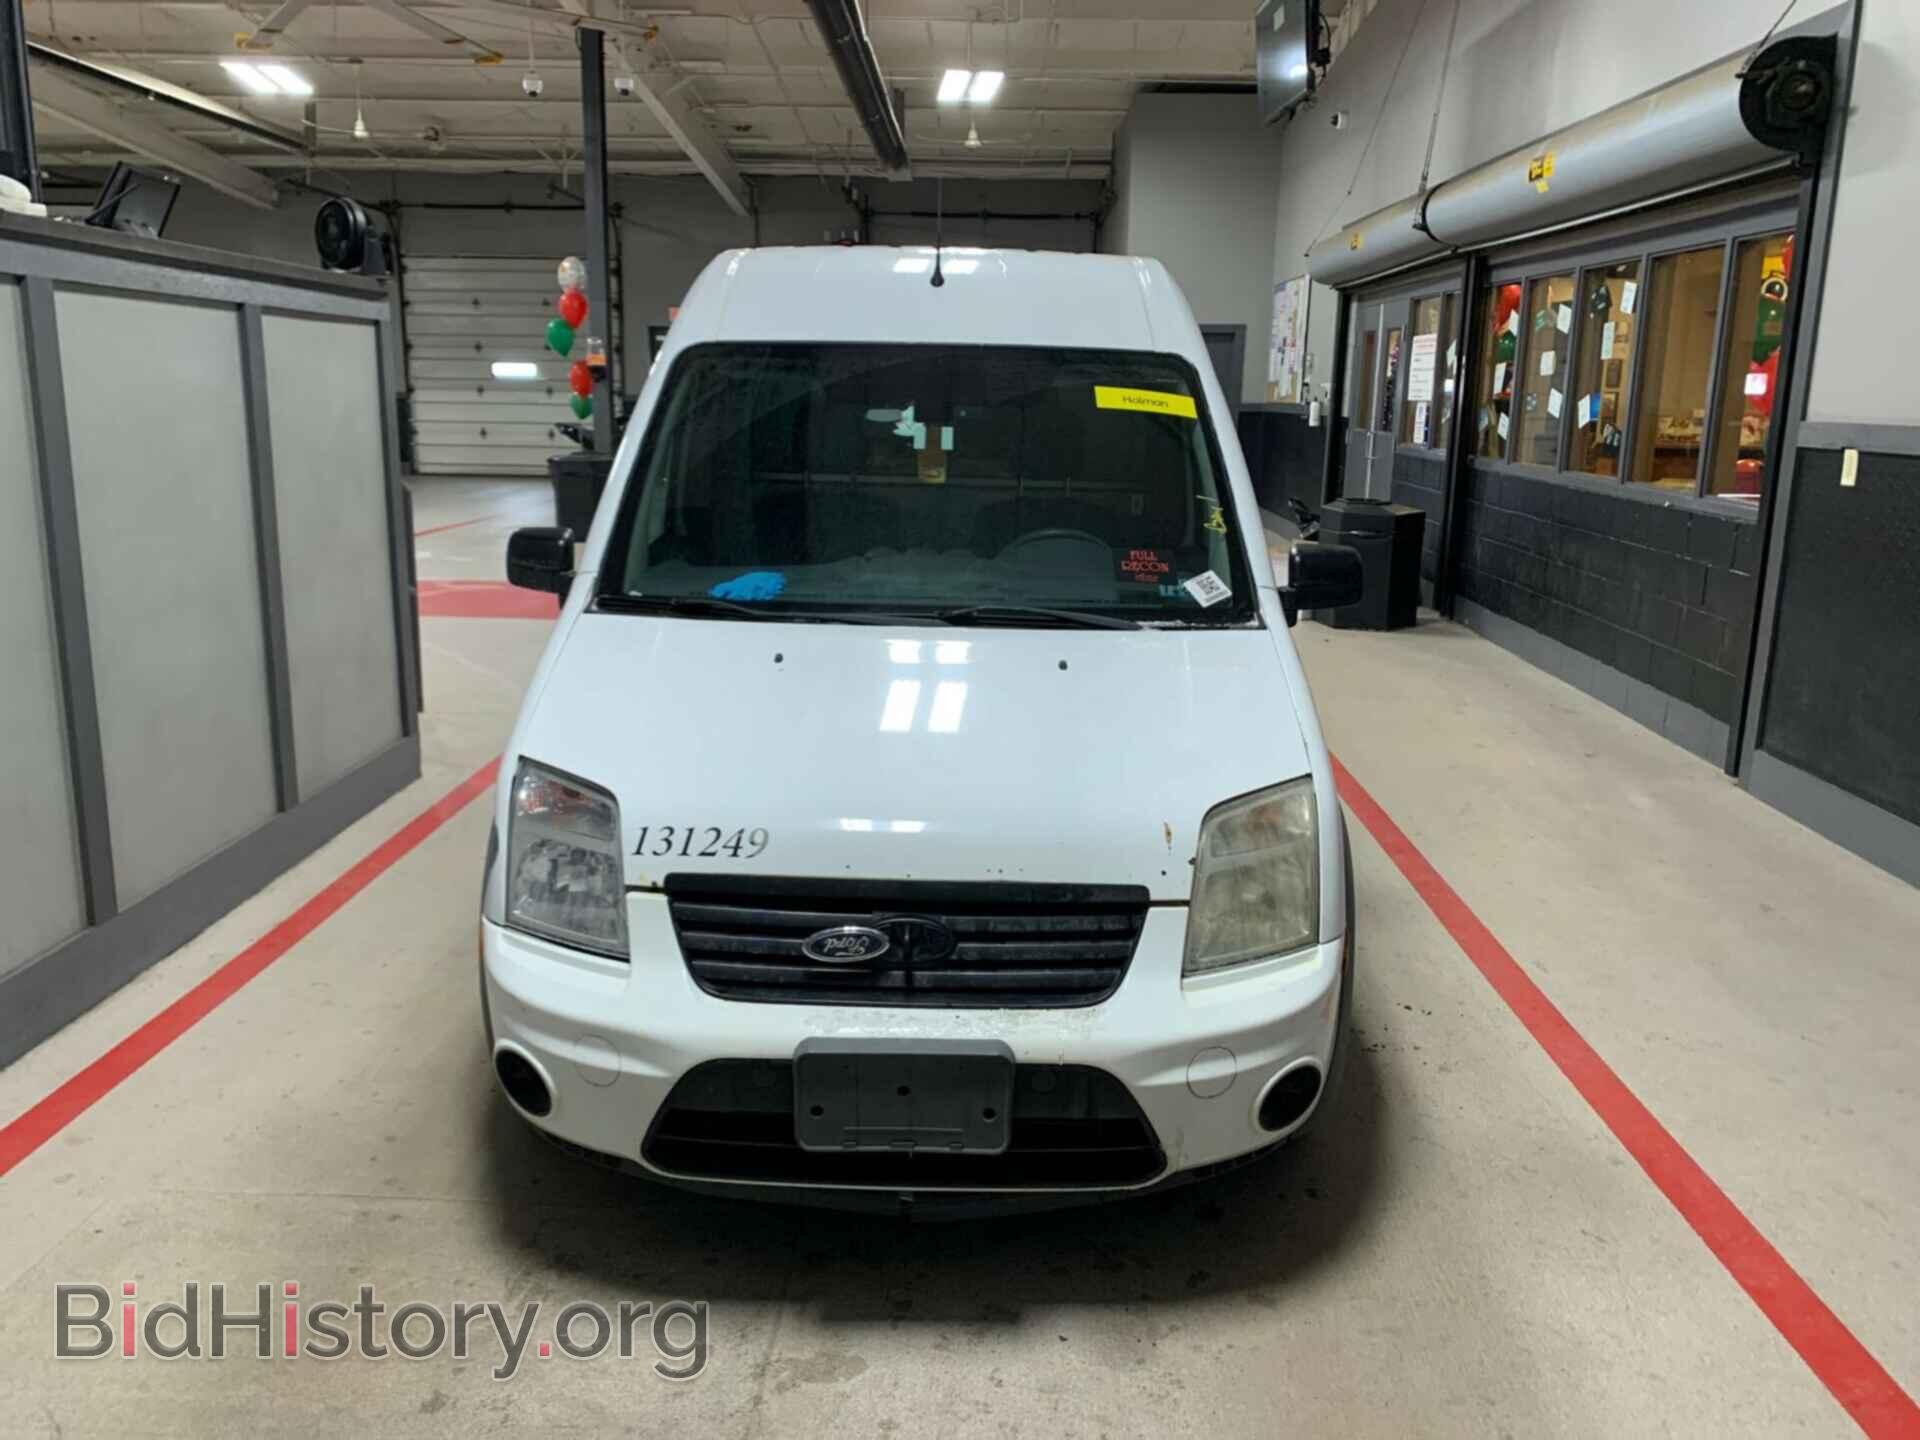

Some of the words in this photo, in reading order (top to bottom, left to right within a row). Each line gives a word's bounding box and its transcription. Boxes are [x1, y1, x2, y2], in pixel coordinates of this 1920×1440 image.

[1129, 550, 1157, 561] FULL
[631, 826, 769, 858] 131249
[823, 935, 870, 956] Ford
